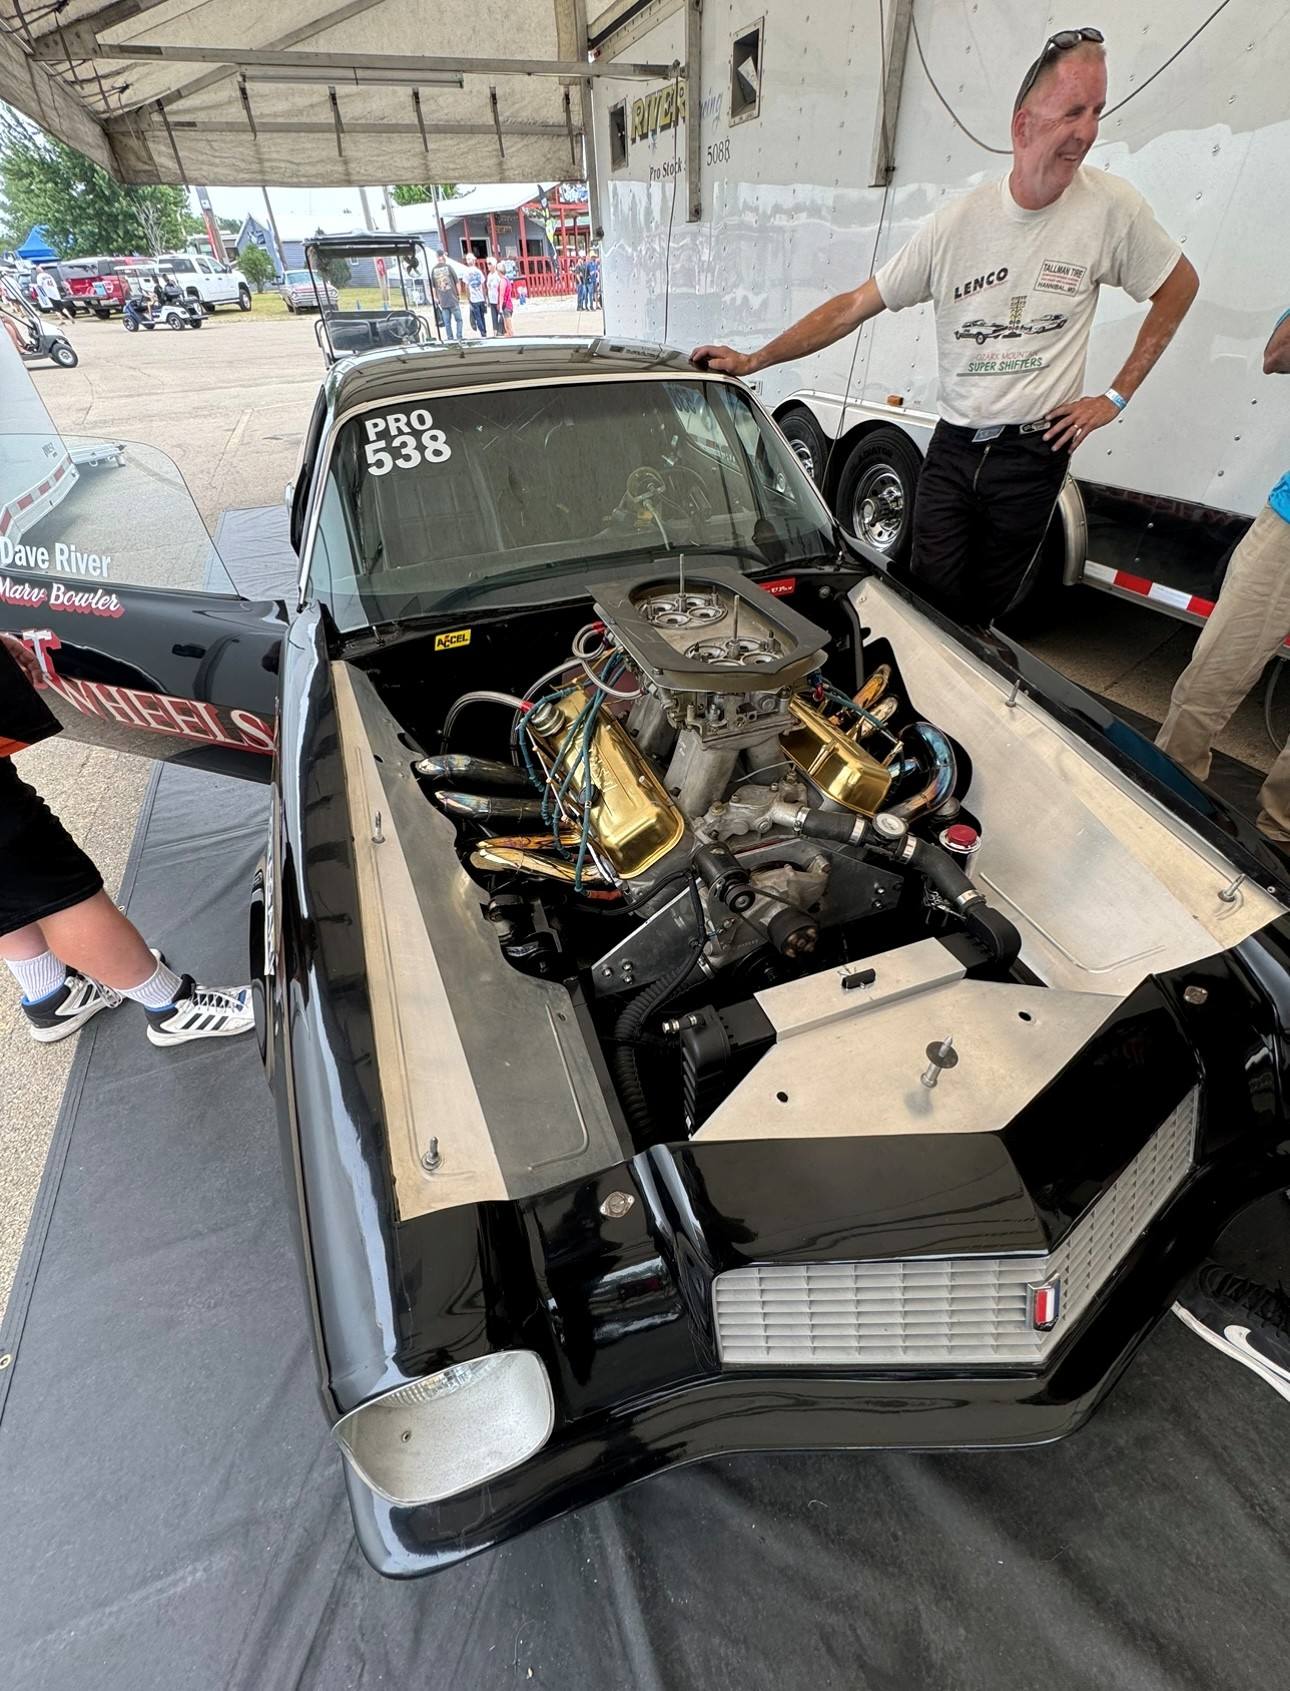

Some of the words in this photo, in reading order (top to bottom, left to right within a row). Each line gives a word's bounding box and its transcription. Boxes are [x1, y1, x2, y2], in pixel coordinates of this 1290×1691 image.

[649, 166, 661, 183] Pro
[662, 157, 683, 178] Stock
[954, 267, 1008, 300] LENCO
[1043, 263, 1071, 276] TALLMAN
[1070, 268, 1084, 279] TIRE
[968, 361, 996, 373] SUPER
[998, 357, 1043, 372] SHIFTERS
[365, 409, 433, 441] PRO
[364, 429, 452, 476] 538
[0, 536, 49, 569] Dave
[55, 542, 111, 577] River
[0, 576, 47, 605] Marv
[49, 582, 123, 614] Bowler
[436, 632, 469, 649] ACCEL
[45, 673, 276, 754] WHEELS
